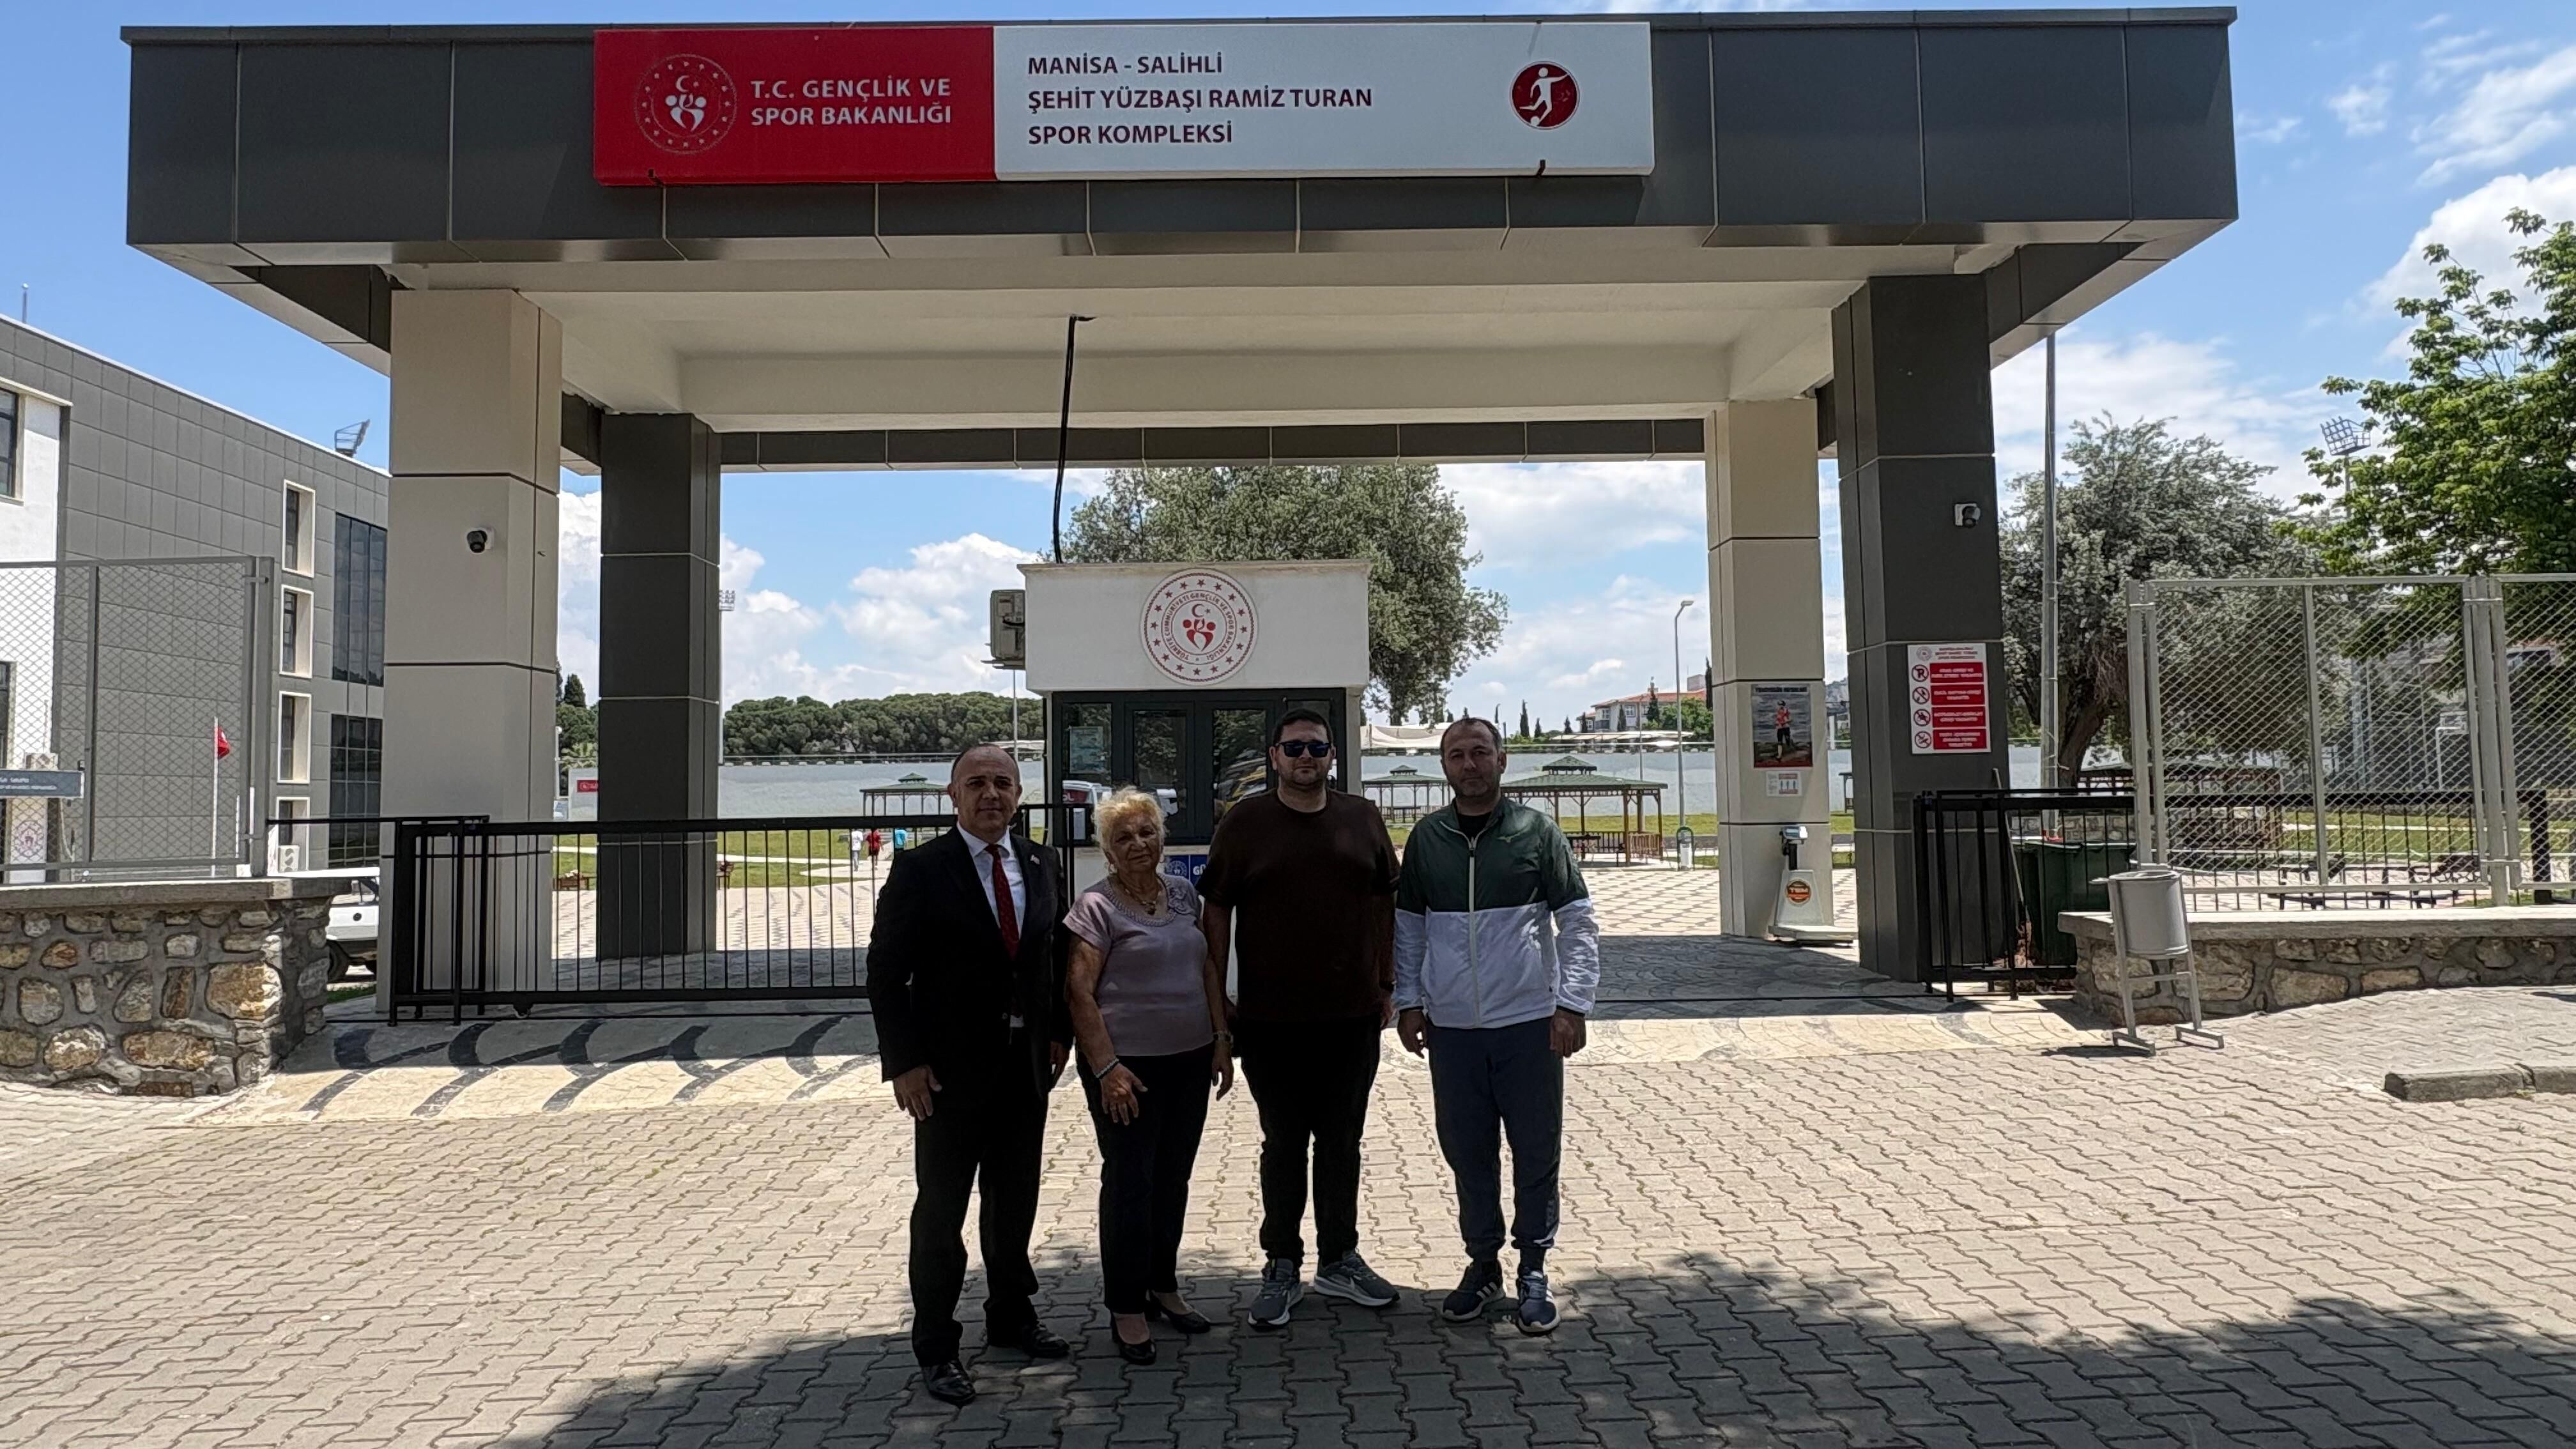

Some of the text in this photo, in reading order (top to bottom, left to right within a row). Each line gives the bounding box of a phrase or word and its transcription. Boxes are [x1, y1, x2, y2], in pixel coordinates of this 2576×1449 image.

[1028, 52, 1119, 75] MANİSA
[1137, 51, 1222, 74] SALİHLİ
[751, 75, 950, 103] T.C. GENÇLİK VE
[1029, 84, 1372, 114] ŞEHİT YÜZBAŞI RAMİZ TURAN
[751, 102, 951, 125] SPOR BAKANLIĞI
[1029, 121, 1232, 145] SPOR KOMPLEKSİ
